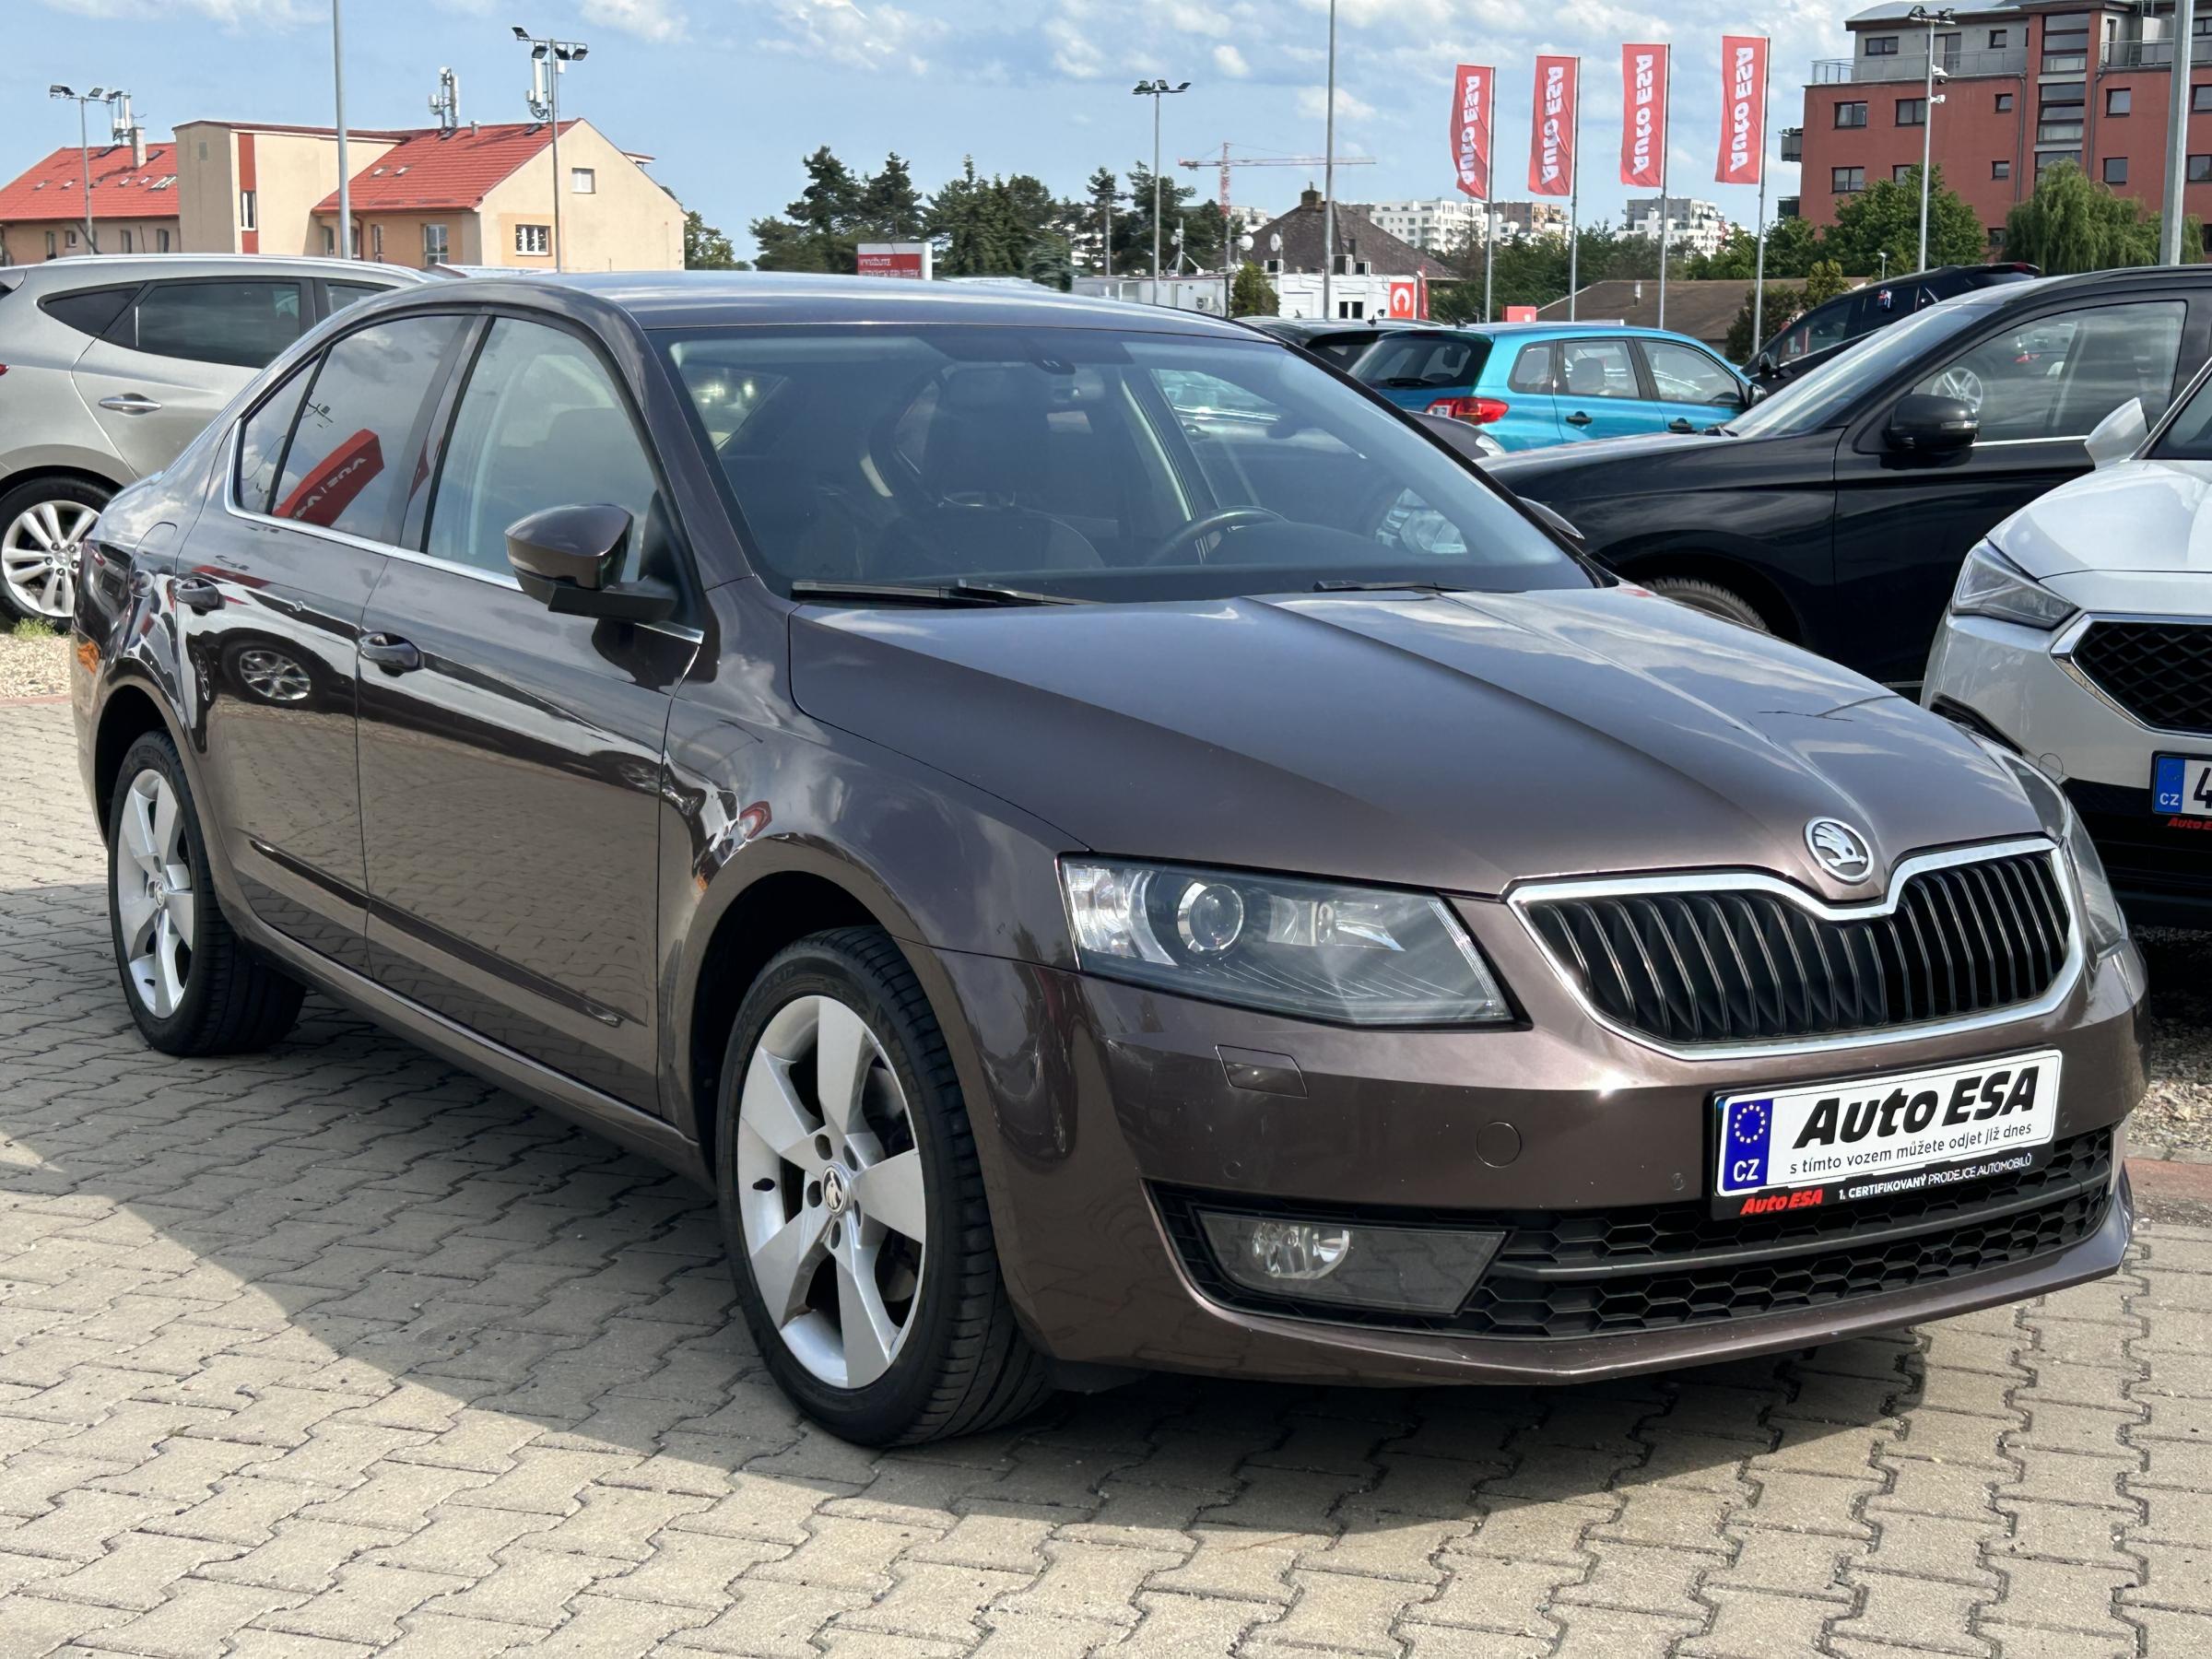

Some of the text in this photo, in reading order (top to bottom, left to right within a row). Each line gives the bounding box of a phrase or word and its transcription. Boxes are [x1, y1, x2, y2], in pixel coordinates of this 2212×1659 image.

[2159, 793, 2180, 806] CZ
[1792, 1065, 2040, 1149] Auto ESA
[1790, 1124, 2031, 1174] s tímto vozem můžete odjet již dnes
[1733, 1159, 1760, 1182] CZ
[1839, 1152, 2032, 1200] 1. CERTIFIKOVANÝ PRODEJCE AUTOMOBILŮ
[1740, 1188, 1824, 1216] Auto ESA
